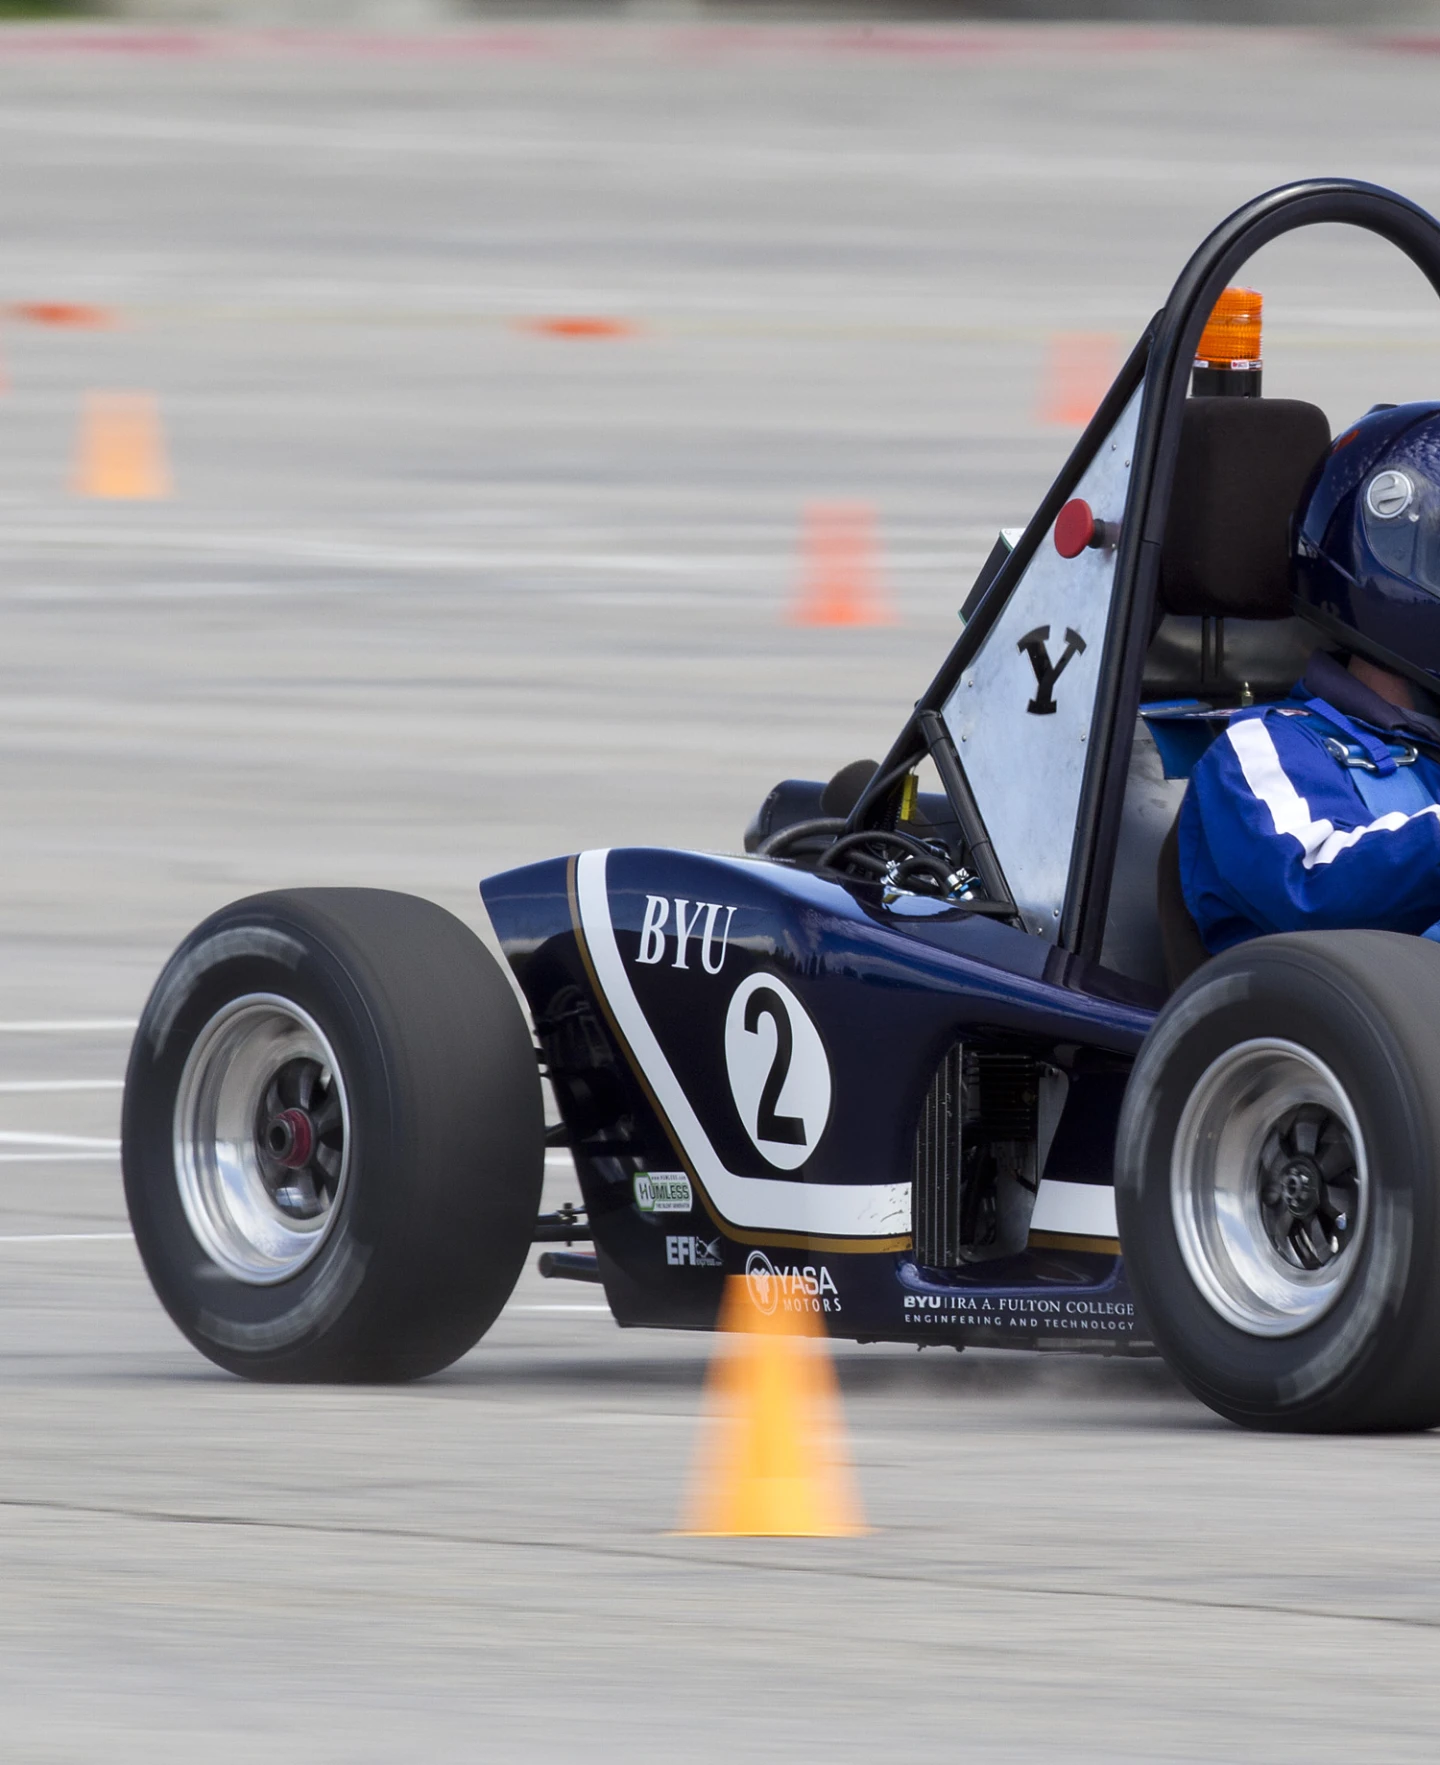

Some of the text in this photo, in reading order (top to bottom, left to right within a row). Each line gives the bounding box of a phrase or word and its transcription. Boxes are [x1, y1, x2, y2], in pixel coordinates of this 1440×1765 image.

[1017, 625, 1087, 715] Y
[635, 895, 737, 974] BYU
[744, 986, 807, 1146] 2
[638, 1183, 690, 1200] HUMLESS
[666, 1236, 696, 1265] EFI
[774, 1266, 838, 1295] YASA
[783, 1298, 842, 1312] MOTORS
[903, 1296, 1135, 1316] BYU IRA A. FULTON COLLEGE
[1009, 1317, 1038, 1327] AND
[1045, 1319, 1135, 1330] TECHNOLOGY
